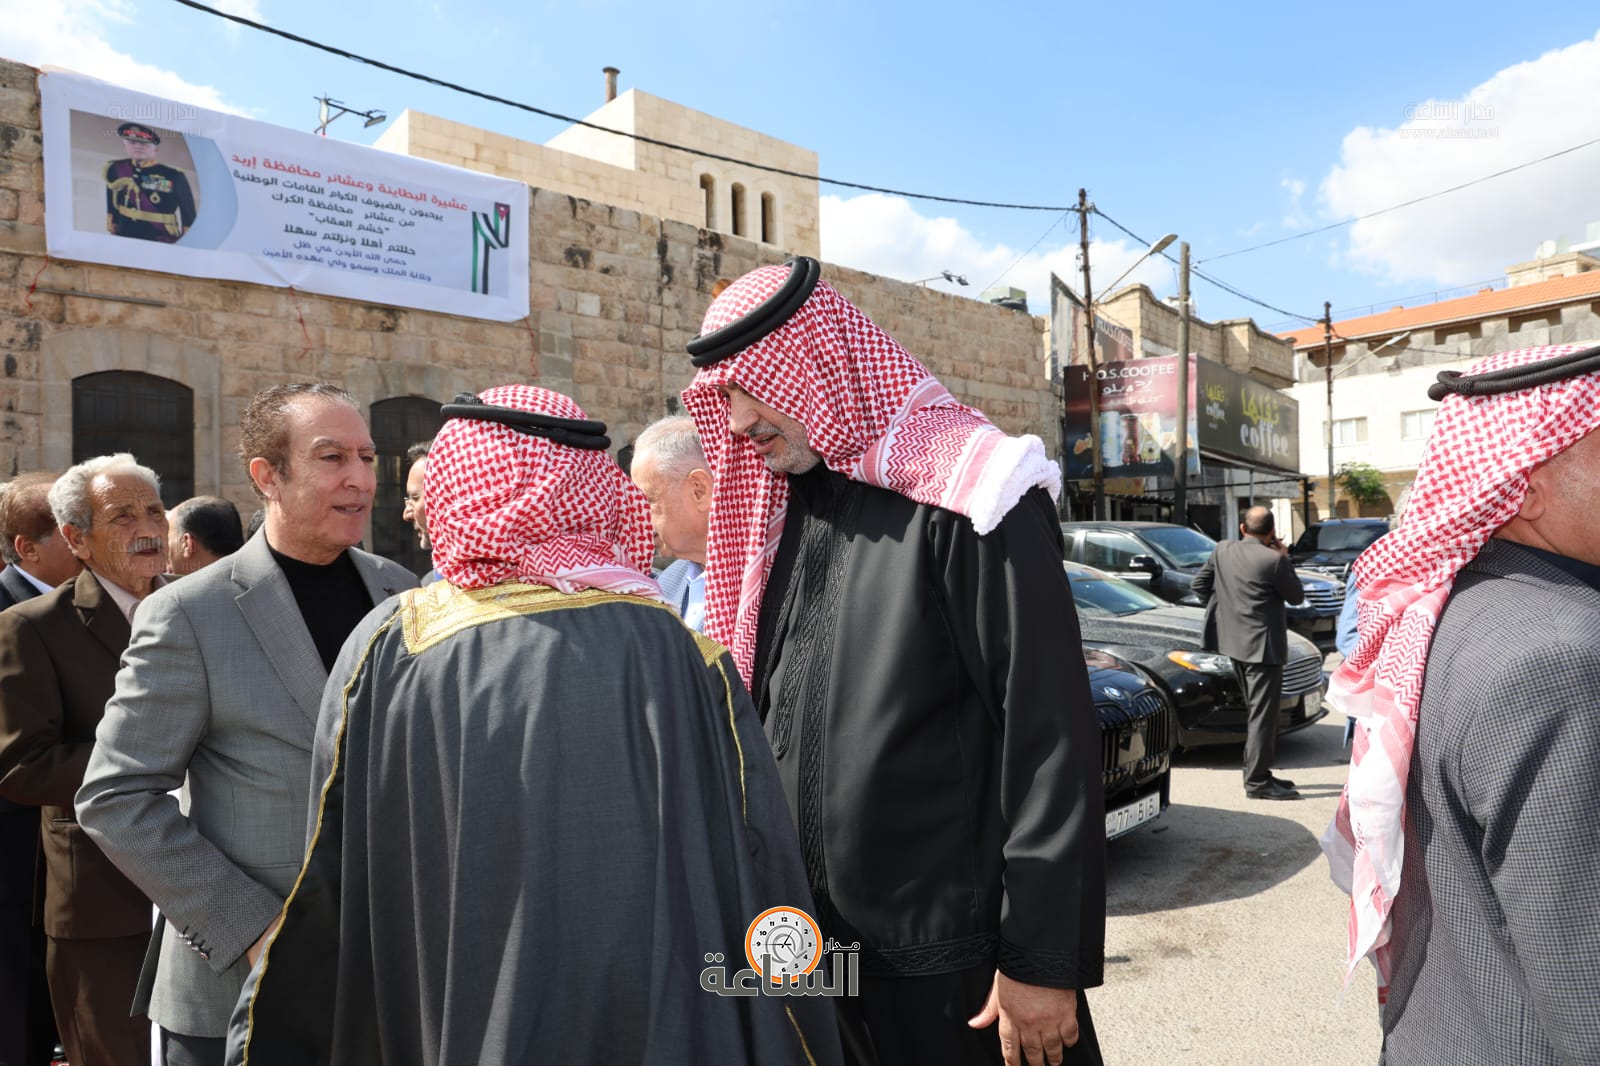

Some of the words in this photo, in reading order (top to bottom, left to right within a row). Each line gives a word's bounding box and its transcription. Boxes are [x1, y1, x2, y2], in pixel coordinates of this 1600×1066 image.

[231, 154, 256, 170] إربد
[262, 158, 321, 178] محافظة
[233, 169, 278, 186] الوطنية
[327, 174, 375, 192] وعشائر
[282, 180, 325, 195] القامات
[378, 183, 428, 203] البطاينة
[271, 193, 304, 205] الكرك
[329, 190, 358, 203] الكرام
[431, 195, 469, 211] عشيرة
[308, 198, 353, 215] محافظة
[361, 196, 406, 213] بالضيوف
[364, 211, 395, 224] عشائر
[409, 207, 444, 222] يرحبون
[398, 218, 415, 228] من
[283, 223, 317, 237] سهلا
[293, 240, 312, 249] ظل
[322, 232, 357, 246] ونزلتم
[360, 237, 383, 249] أهلا
[262, 248, 293, 259] الأمين
[315, 245, 332, 253] في
[387, 245, 416, 256] حللتم
[295, 254, 324, 263] عهده
[327, 257, 347, 268] ولي
[364, 252, 381, 261] الله
[350, 262, 379, 273] وسمو
[382, 267, 407, 277] الملك
[409, 271, 432, 282] جلالة
[1240, 419, 1288, 458] coffee
